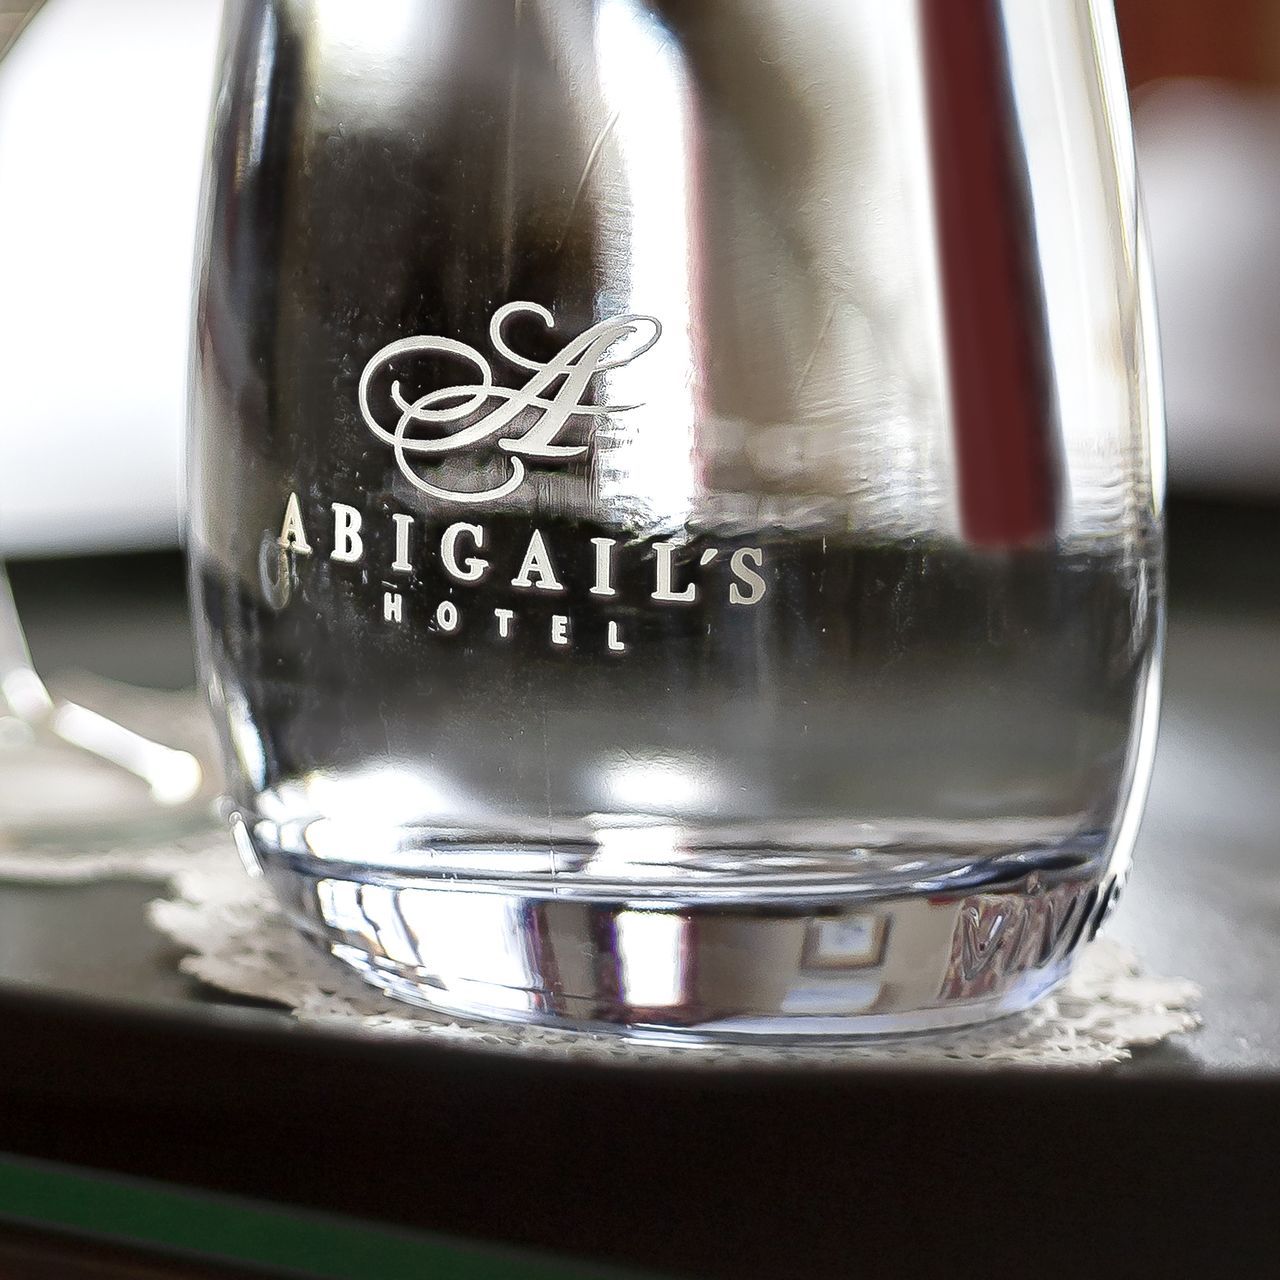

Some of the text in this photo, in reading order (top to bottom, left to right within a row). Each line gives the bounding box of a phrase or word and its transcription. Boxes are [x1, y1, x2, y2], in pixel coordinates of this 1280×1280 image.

[358, 301, 662, 502] A
[280, 492, 766, 605] ABIGAIL'S
[383, 592, 625, 650] HOTEL
